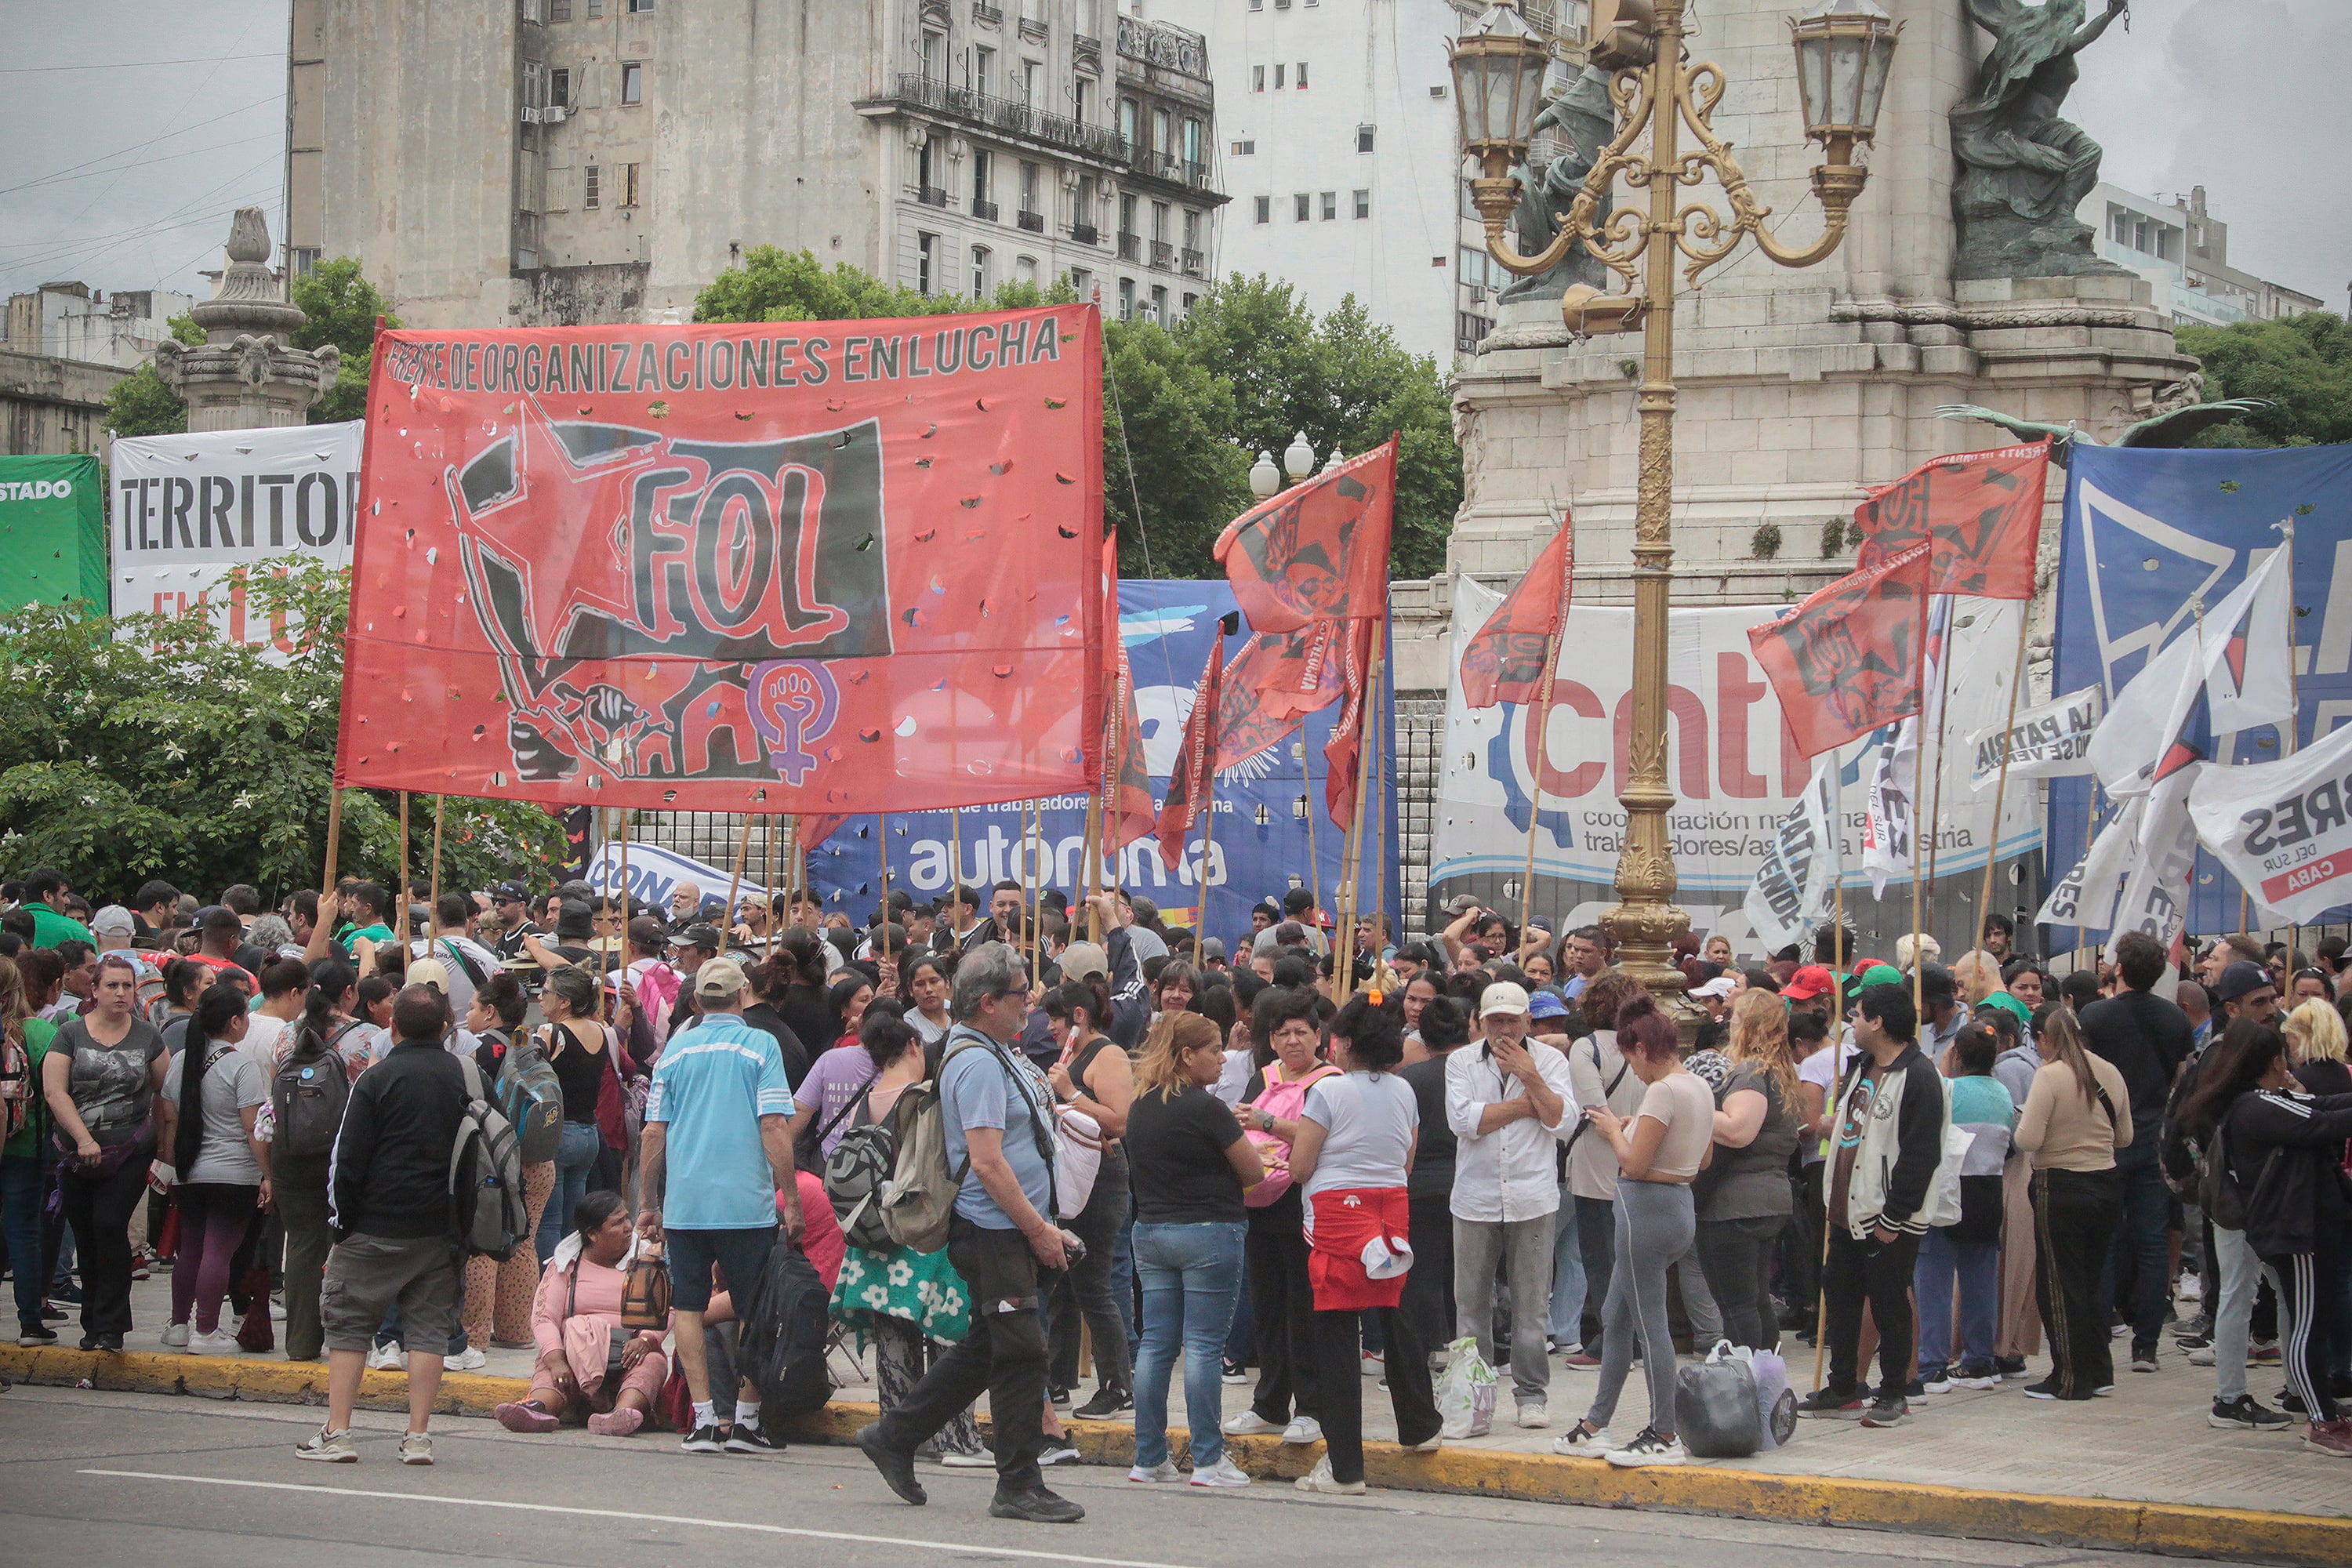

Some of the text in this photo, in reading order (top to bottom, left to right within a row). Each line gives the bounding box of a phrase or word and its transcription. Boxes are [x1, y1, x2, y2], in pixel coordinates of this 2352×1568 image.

[387, 315, 1061, 394] FRENTE DE ORGANIZACIONES EN LUCHA
[630, 463, 837, 635] FOL
[1301, 652, 1322, 690] LUCHA
[1193, 693, 1208, 781] ORGANIZACIONES
[909, 822, 1228, 887] autónoma
[1874, 815, 1887, 842] SUR
